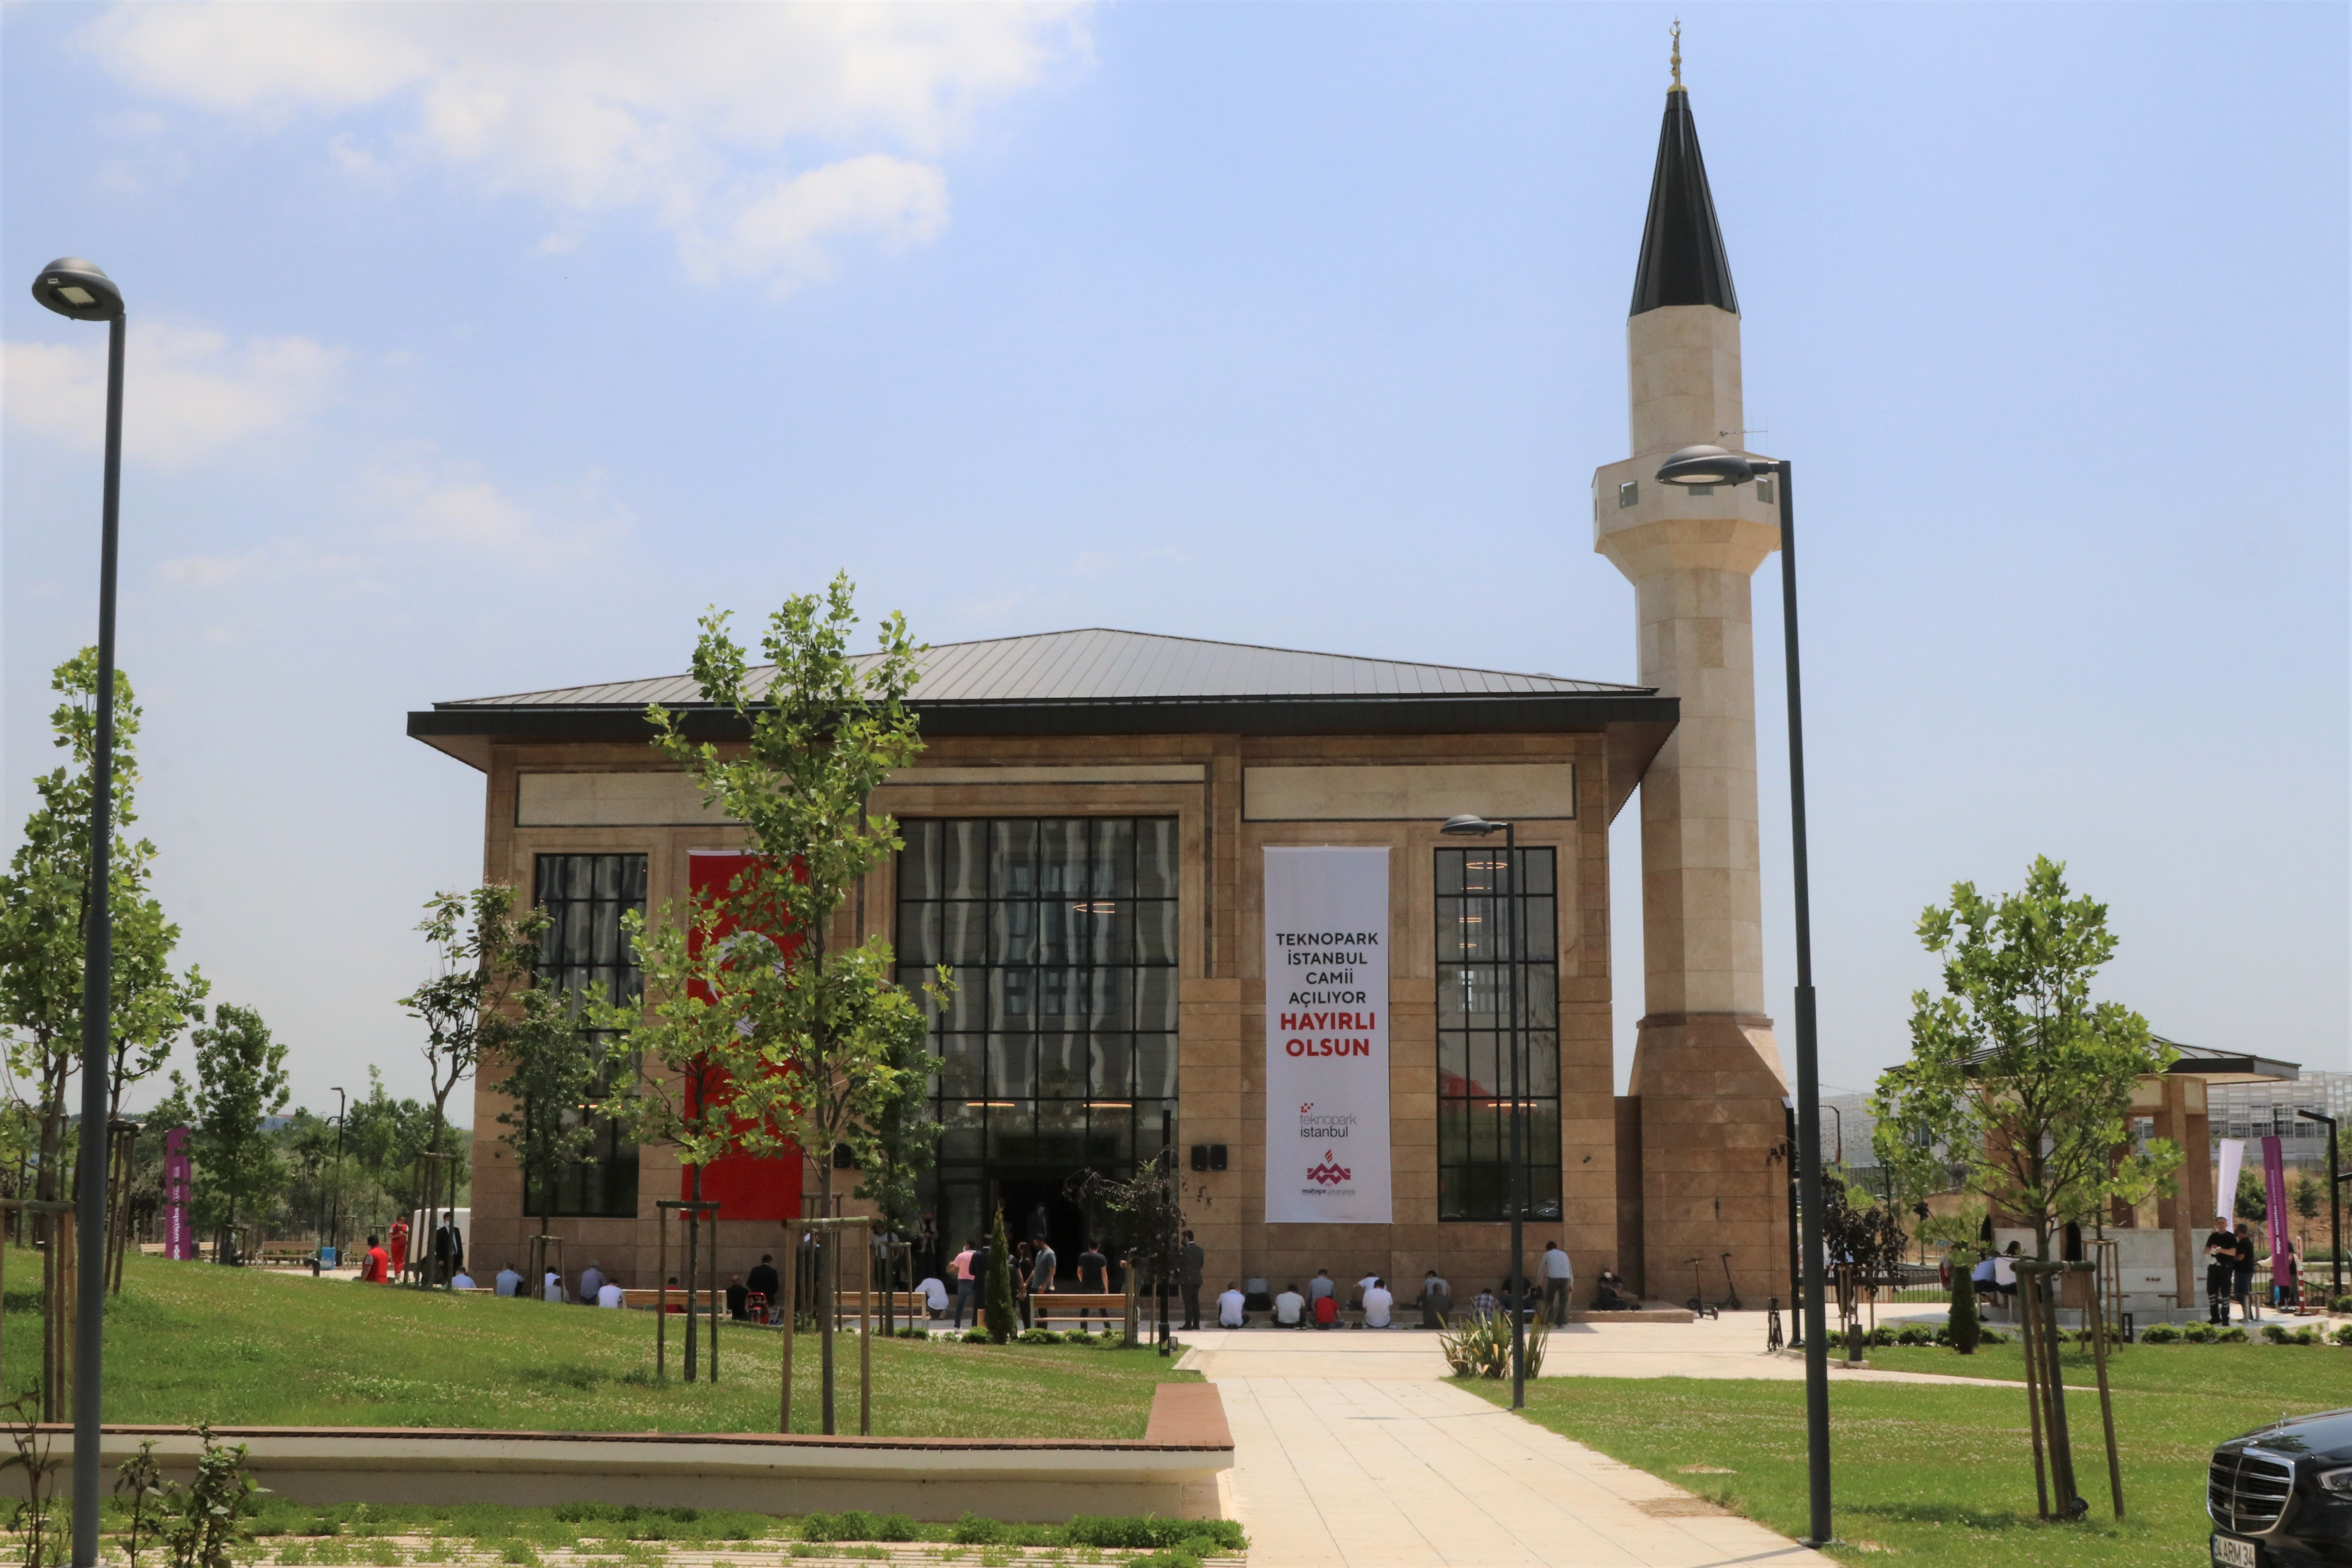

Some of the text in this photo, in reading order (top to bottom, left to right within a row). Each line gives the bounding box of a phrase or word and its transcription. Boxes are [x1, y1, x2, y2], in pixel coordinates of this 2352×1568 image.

[1276, 933, 1378, 946] TEKNOPARK
[1288, 949, 1368, 965] İSTANBUL
[1306, 968, 1353, 984] CAMİİ
[1288, 991, 1366, 1007] AÇILIYOR
[1281, 1012, 1375, 1030] HAYIRLI
[1286, 1038, 1369, 1057] OLSUN
[1300, 1114, 1357, 1126] teknopark
[1300, 1126, 1348, 1137] istanbul
[2223, 1540, 2241, 1565] ARM
[2243, 1546, 2254, 1568] 34
